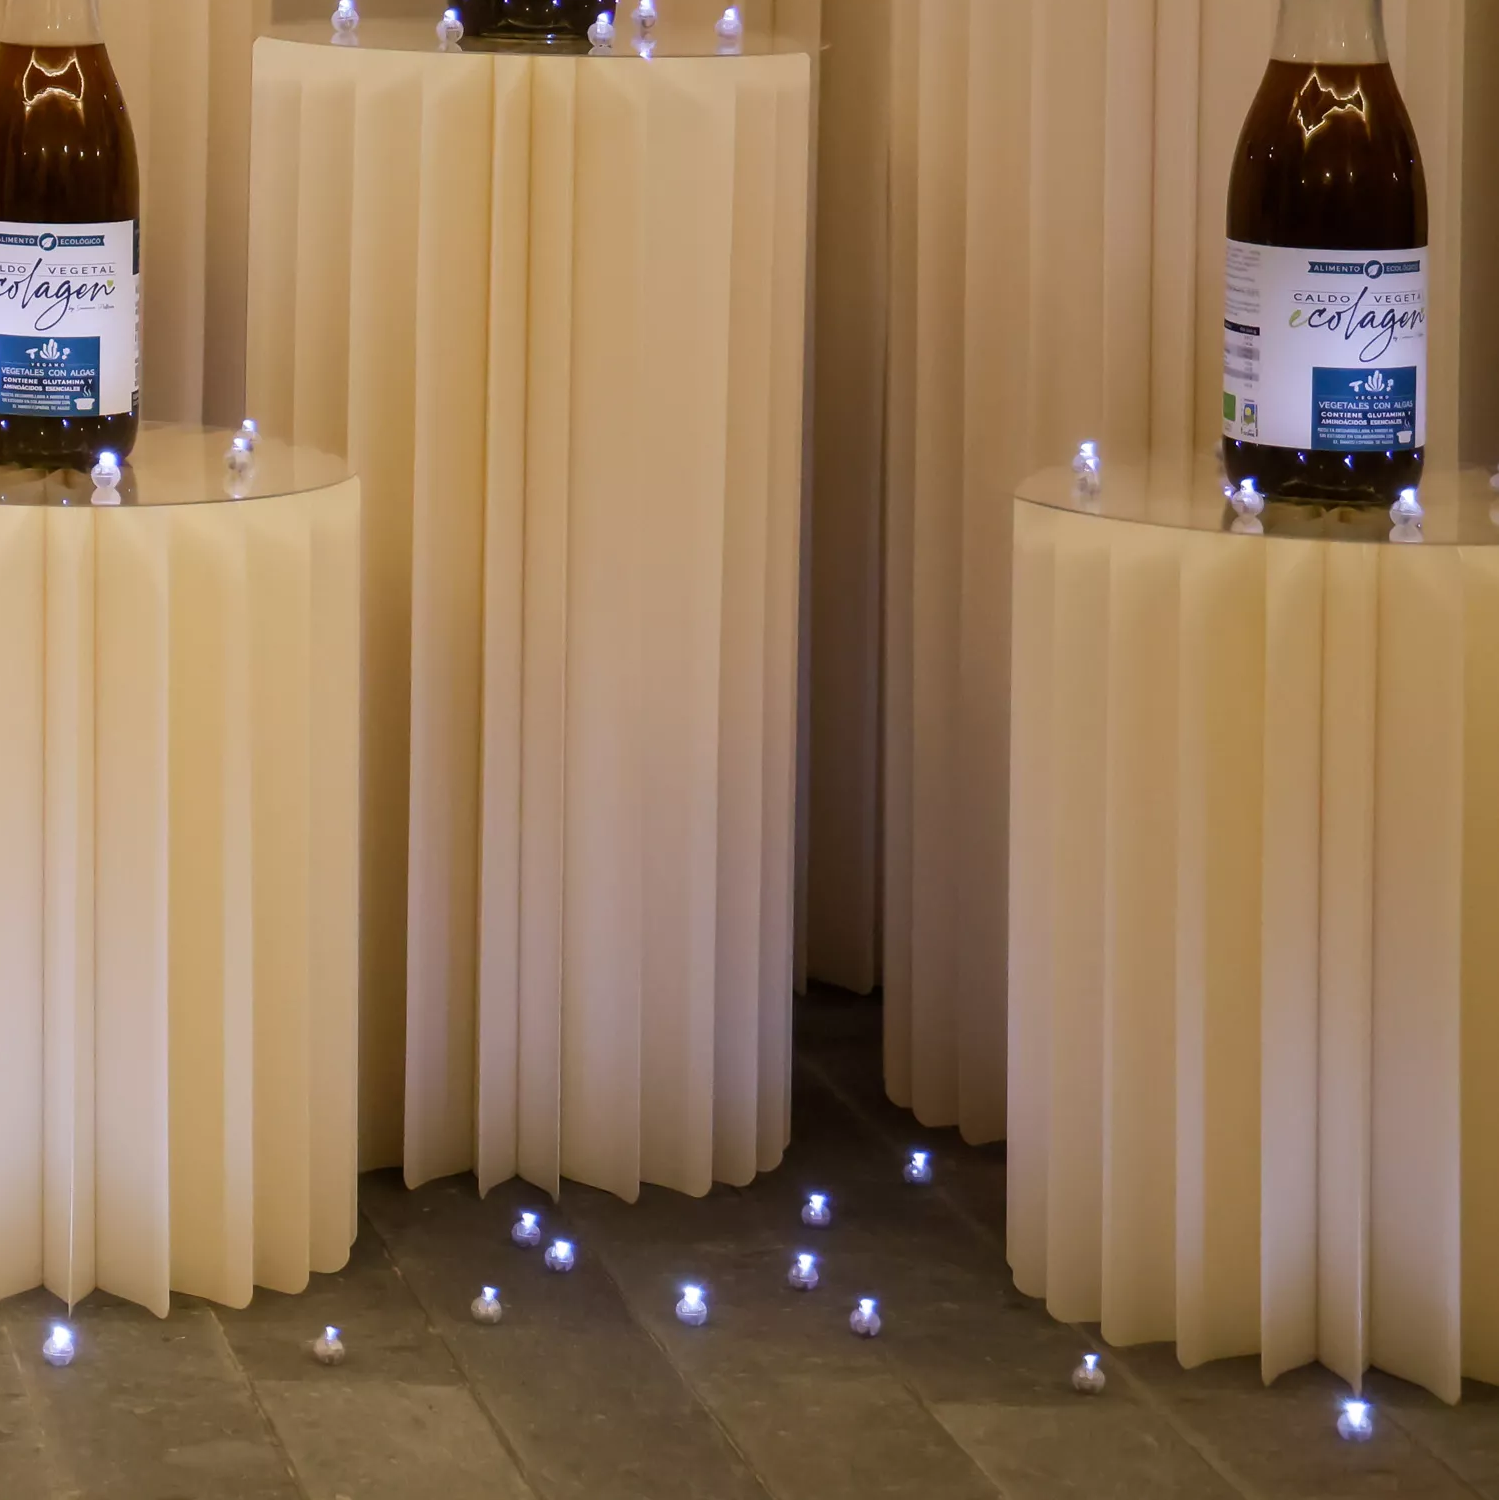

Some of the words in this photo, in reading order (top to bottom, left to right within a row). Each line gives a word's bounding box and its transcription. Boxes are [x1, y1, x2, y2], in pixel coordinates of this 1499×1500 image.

[61, 237, 101, 245] ECOLÓGICO
[48, 266, 114, 274] VEGETAL
[1314, 264, 1360, 272] ALIMENTO
[1294, 293, 1350, 302] CALDO
[1374, 293, 1421, 303] VEGETA
[1, 367, 44, 377] VEGETALES
[1319, 401, 1369, 410] VEGETALES
